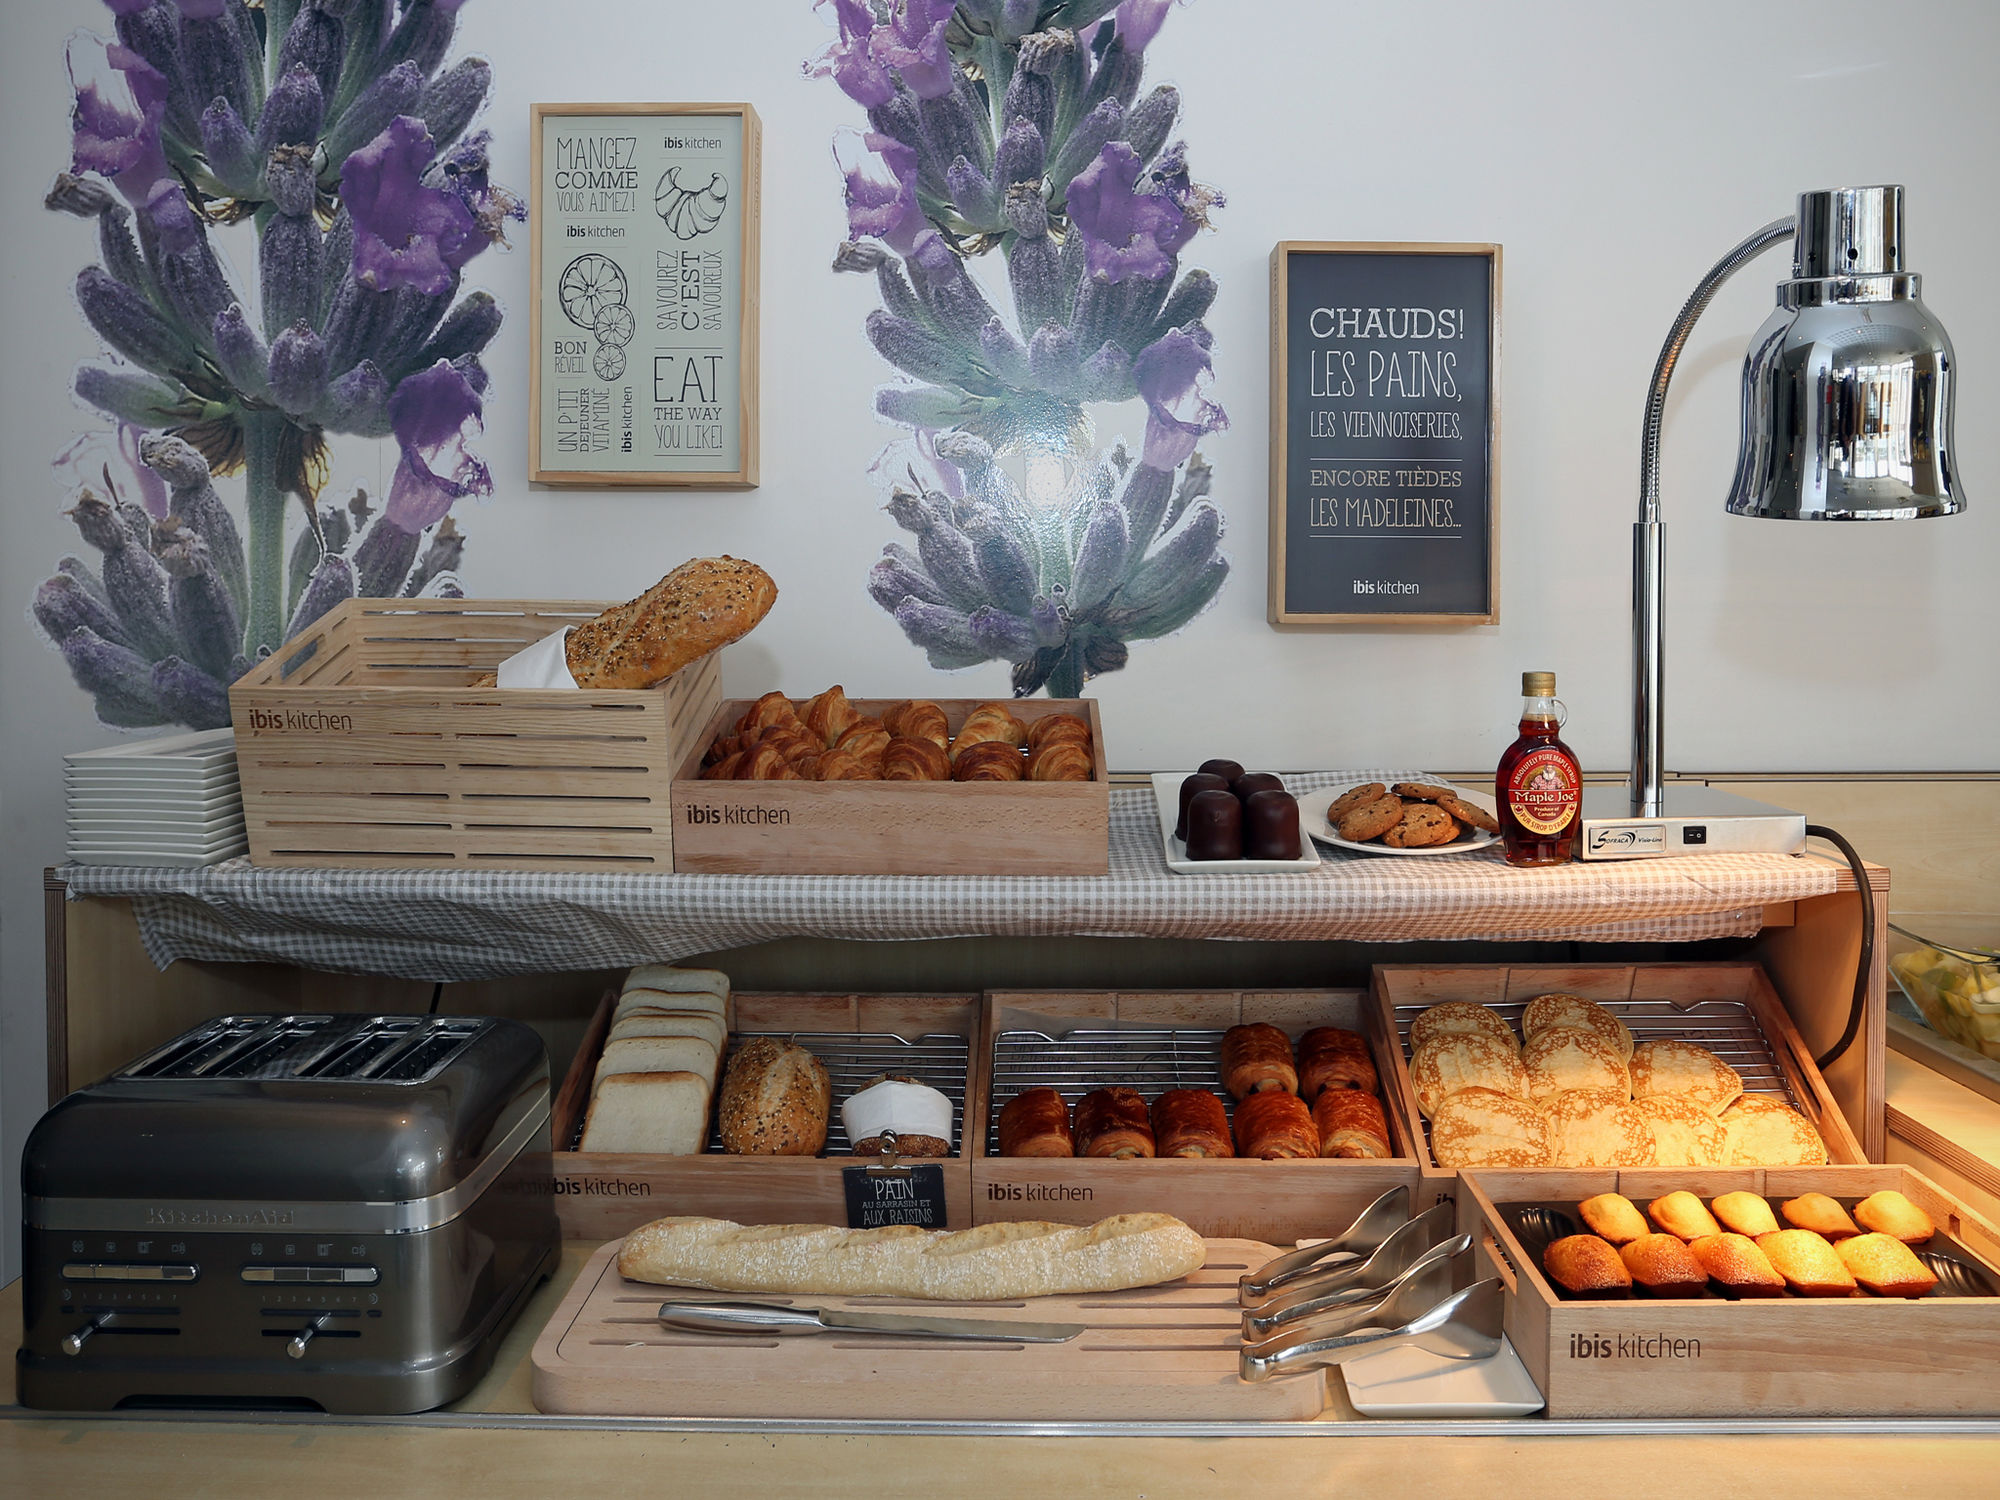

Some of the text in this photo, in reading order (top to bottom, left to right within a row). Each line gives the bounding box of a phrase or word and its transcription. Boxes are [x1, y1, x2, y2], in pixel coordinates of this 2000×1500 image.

[556, 137, 637, 170] MANGEZ
[664, 136, 722, 149] ibis kitchen
[555, 171, 638, 189] COMME
[556, 191, 585, 212] VOUS
[567, 225, 625, 238] ibis kitchen
[656, 250, 679, 330] SAVOUREZ
[681, 250, 700, 331] C'EST
[703, 250, 723, 331] SAVOUREUX
[1309, 307, 1464, 340] CHAUDS!
[554, 341, 588, 355] BON
[554, 355, 588, 374] RÉVEIL
[654, 356, 723, 403] EAT
[1311, 350, 1463, 402] LES PAINS,
[592, 387, 610, 453] VITAMINÉ
[621, 386, 633, 453] ibis kitchen
[653, 407, 723, 421] THE WAY
[653, 424, 723, 449] YOU LIKE!
[1310, 411, 1463, 441] LES VIENNOISERIES,
[557, 431, 578, 453] UN
[1310, 465, 1462, 488] ENCORE TIÈDES
[1310, 497, 1338, 527] LES
[1353, 579, 1420, 595] ibis kitchen
[249, 709, 352, 730] ibis kitchen
[1514, 791, 1575, 804] Maple Joe
[687, 804, 790, 824] ibis kitchen
[553, 1177, 581, 1195] bis
[584, 1177, 651, 1196] kitchen
[875, 1178, 915, 1200] PAIN
[987, 1183, 1093, 1201] ibis kitchen
[862, 1199, 932, 1209] AU SARRASIN ET
[863, 1208, 934, 1225] AUX RAISINS
[1570, 1332, 1701, 1358] ibis kitchen
